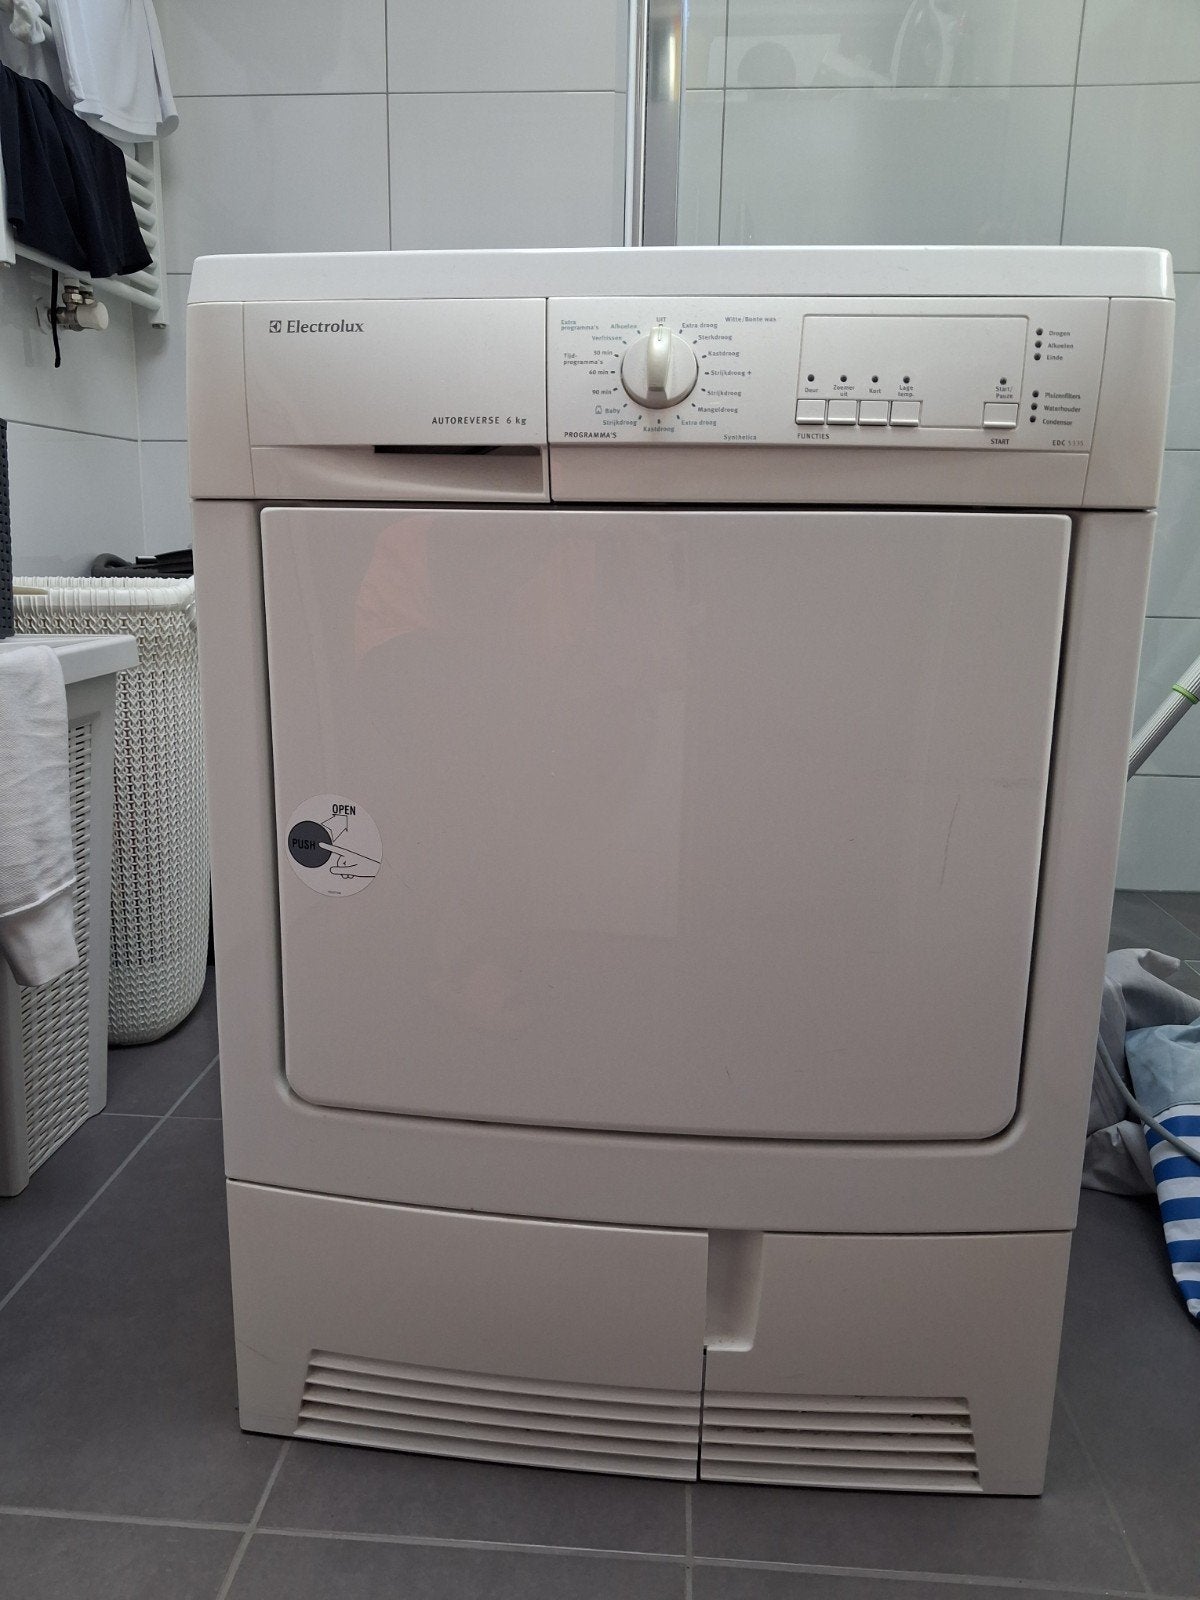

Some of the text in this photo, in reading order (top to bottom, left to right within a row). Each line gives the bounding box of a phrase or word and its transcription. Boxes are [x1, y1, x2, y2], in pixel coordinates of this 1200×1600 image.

[287, 319, 364, 333] Electrolux
[432, 416, 527, 426] AUTOREVERSE 6 kg
[332, 804, 356, 816] OPEN
[292, 838, 316, 850] PUSH
